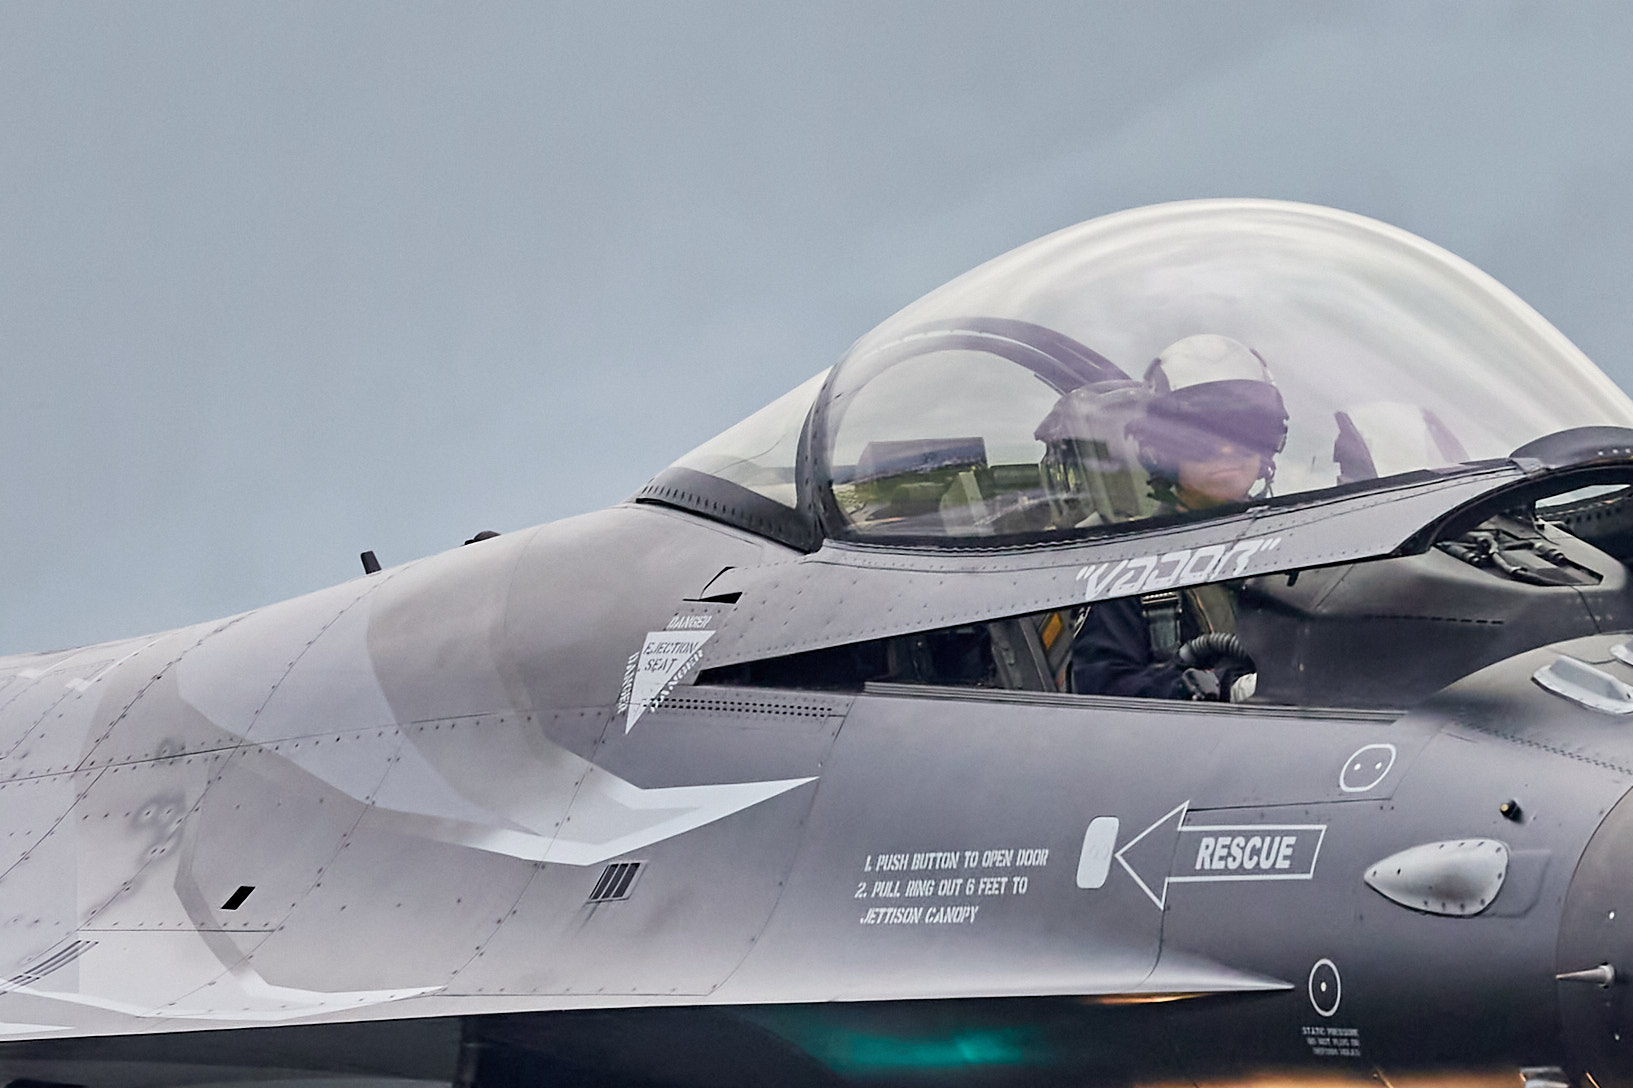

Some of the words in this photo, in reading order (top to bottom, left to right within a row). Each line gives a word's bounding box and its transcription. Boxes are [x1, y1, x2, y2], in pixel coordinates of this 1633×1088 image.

[666, 615, 712, 629] DANGER
[643, 642, 699, 655] EJECTION
[644, 658, 677, 673] SEAT
[864, 855, 872, 872] 1.
[876, 853, 909, 872] PUSH
[911, 852, 960, 870] BUTTON
[963, 851, 979, 868] TO
[981, 849, 1013, 868] OPEN
[1016, 849, 1049, 867] DOOR
[1195, 836, 1297, 870] RESCUE
[854, 882, 867, 899] 2.
[871, 881, 900, 898] PULL
[905, 879, 935, 897] RING
[937, 879, 963, 896] OUT
[965, 878, 975, 895] 6
[978, 877, 1008, 895] FEET
[1012, 876, 1028, 894] TO
[860, 907, 922, 924] JETTISON
[925, 906, 979, 923] CANOPY
